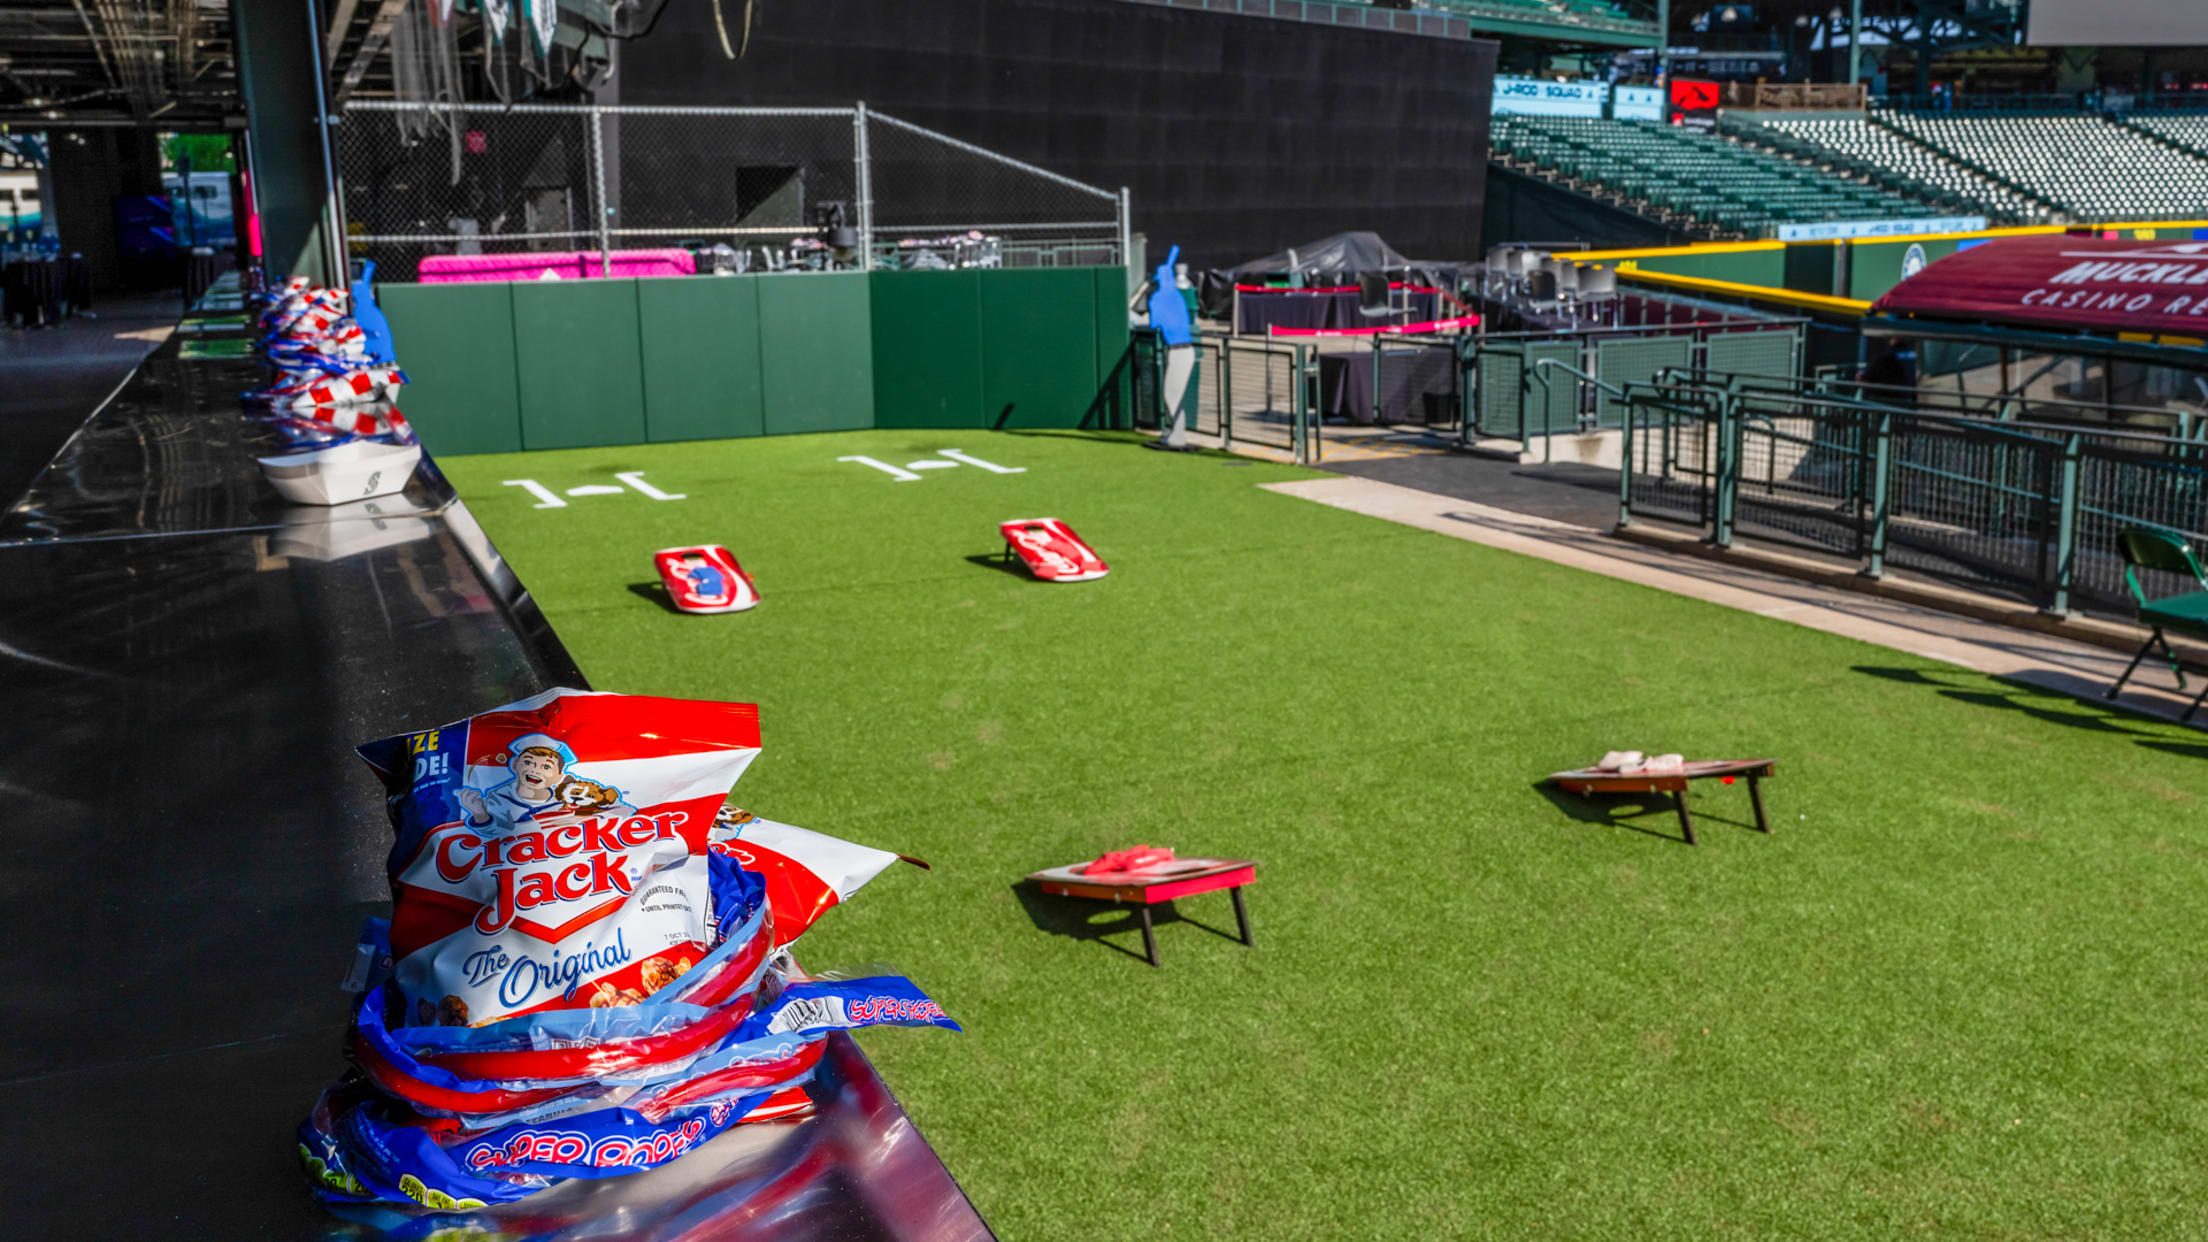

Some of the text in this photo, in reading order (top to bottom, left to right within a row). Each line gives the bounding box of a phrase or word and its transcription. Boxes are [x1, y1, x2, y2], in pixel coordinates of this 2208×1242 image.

[2021, 288, 2152, 312] CASINO
[436, 811, 687, 883] Cracker
[474, 851, 633, 935] Jack
[462, 926, 631, 1009] The Original
[466, 1130, 589, 1168] SUPER
